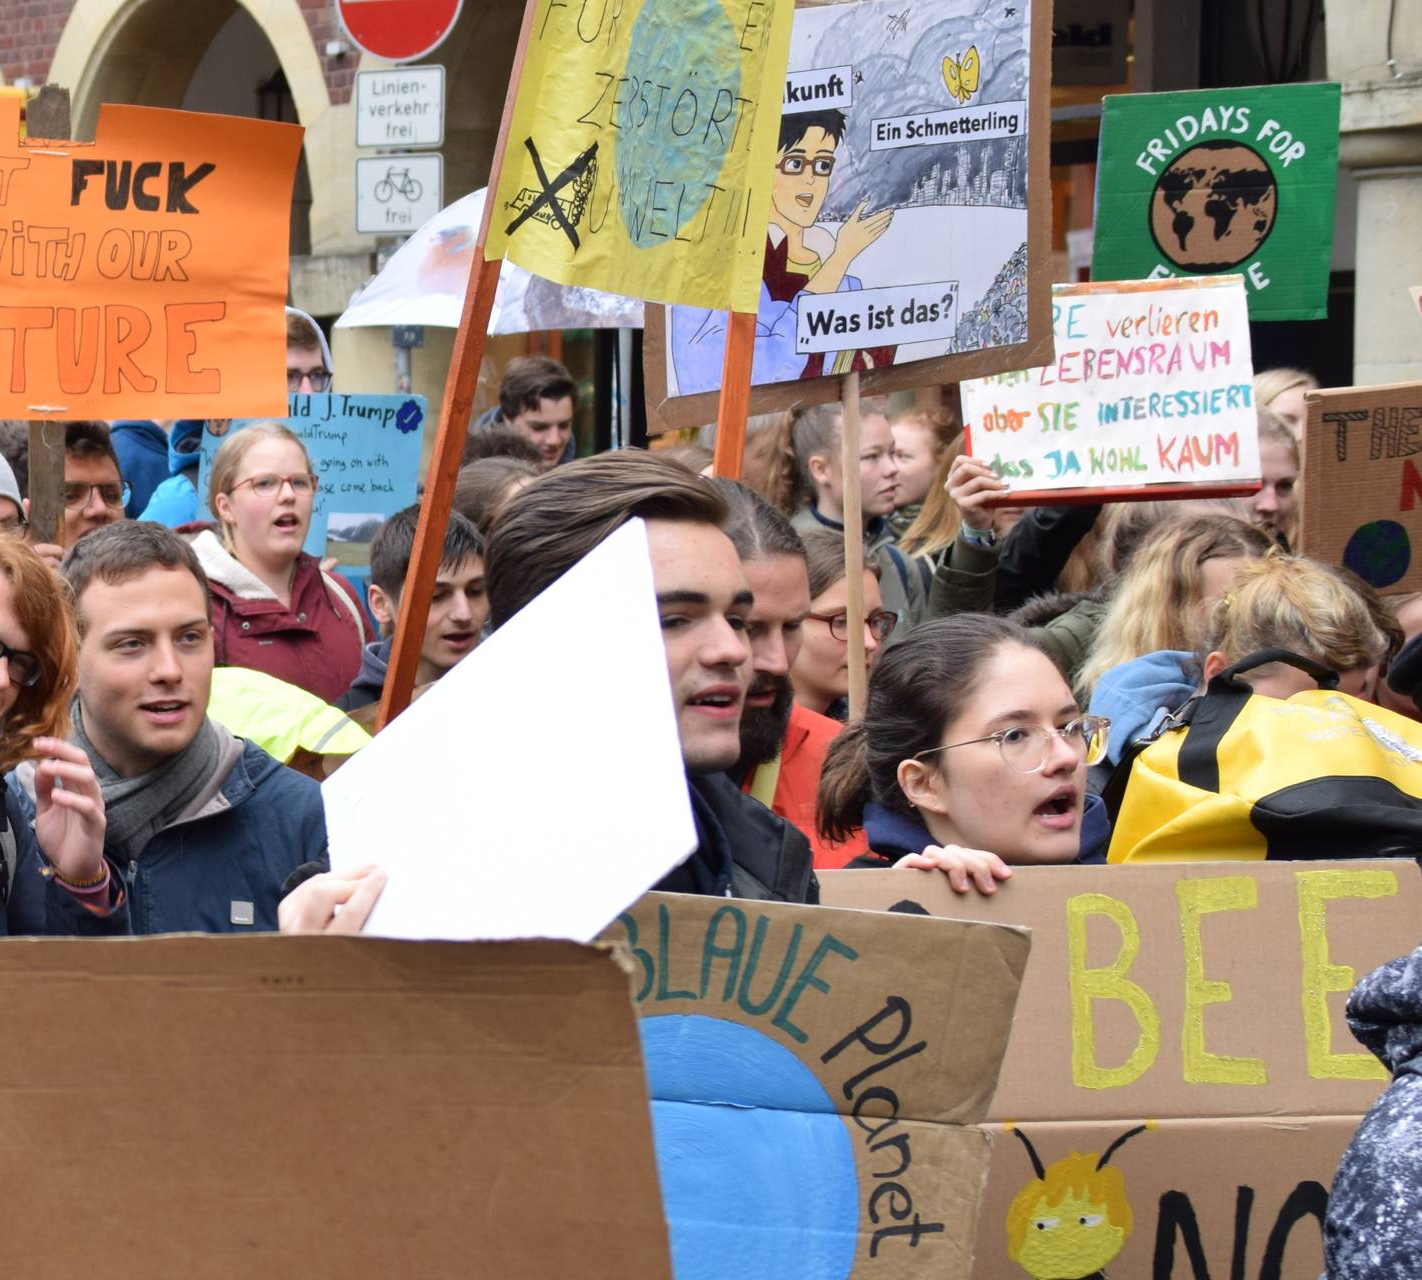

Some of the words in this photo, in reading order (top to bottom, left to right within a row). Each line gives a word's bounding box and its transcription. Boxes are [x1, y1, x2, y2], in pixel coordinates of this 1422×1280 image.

[371, 79, 427, 96] Linien-
[782, 75, 844, 104] kunft
[369, 101, 430, 117] verkehr
[385, 121, 413, 137] frei
[877, 123, 901, 141] Ein
[906, 112, 1019, 140] Schmetterling
[1136, 105, 1251, 175] FRIDAYS
[1256, 119, 1306, 168] FOR
[69, 158, 217, 215] FUCK
[385, 207, 412, 223] frei
[96, 227, 193, 282] OUR
[868, 303, 894, 330] ist
[1106, 304, 1219, 339] verlieren
[1040, 340, 1231, 386] LEBENSRAUM
[340, 394, 396, 428] Trump
[1037, 401, 1081, 433] SIE
[1098, 384, 1253, 426] INTERESSIERT
[319, 457, 347, 473] going
[350, 458, 363, 469] on
[367, 452, 390, 468] with
[1043, 449, 1082, 480] JA
[1089, 446, 1148, 475] WOHL
[1157, 431, 1241, 474] KAUM
[821, 995, 945, 1258] Planet
